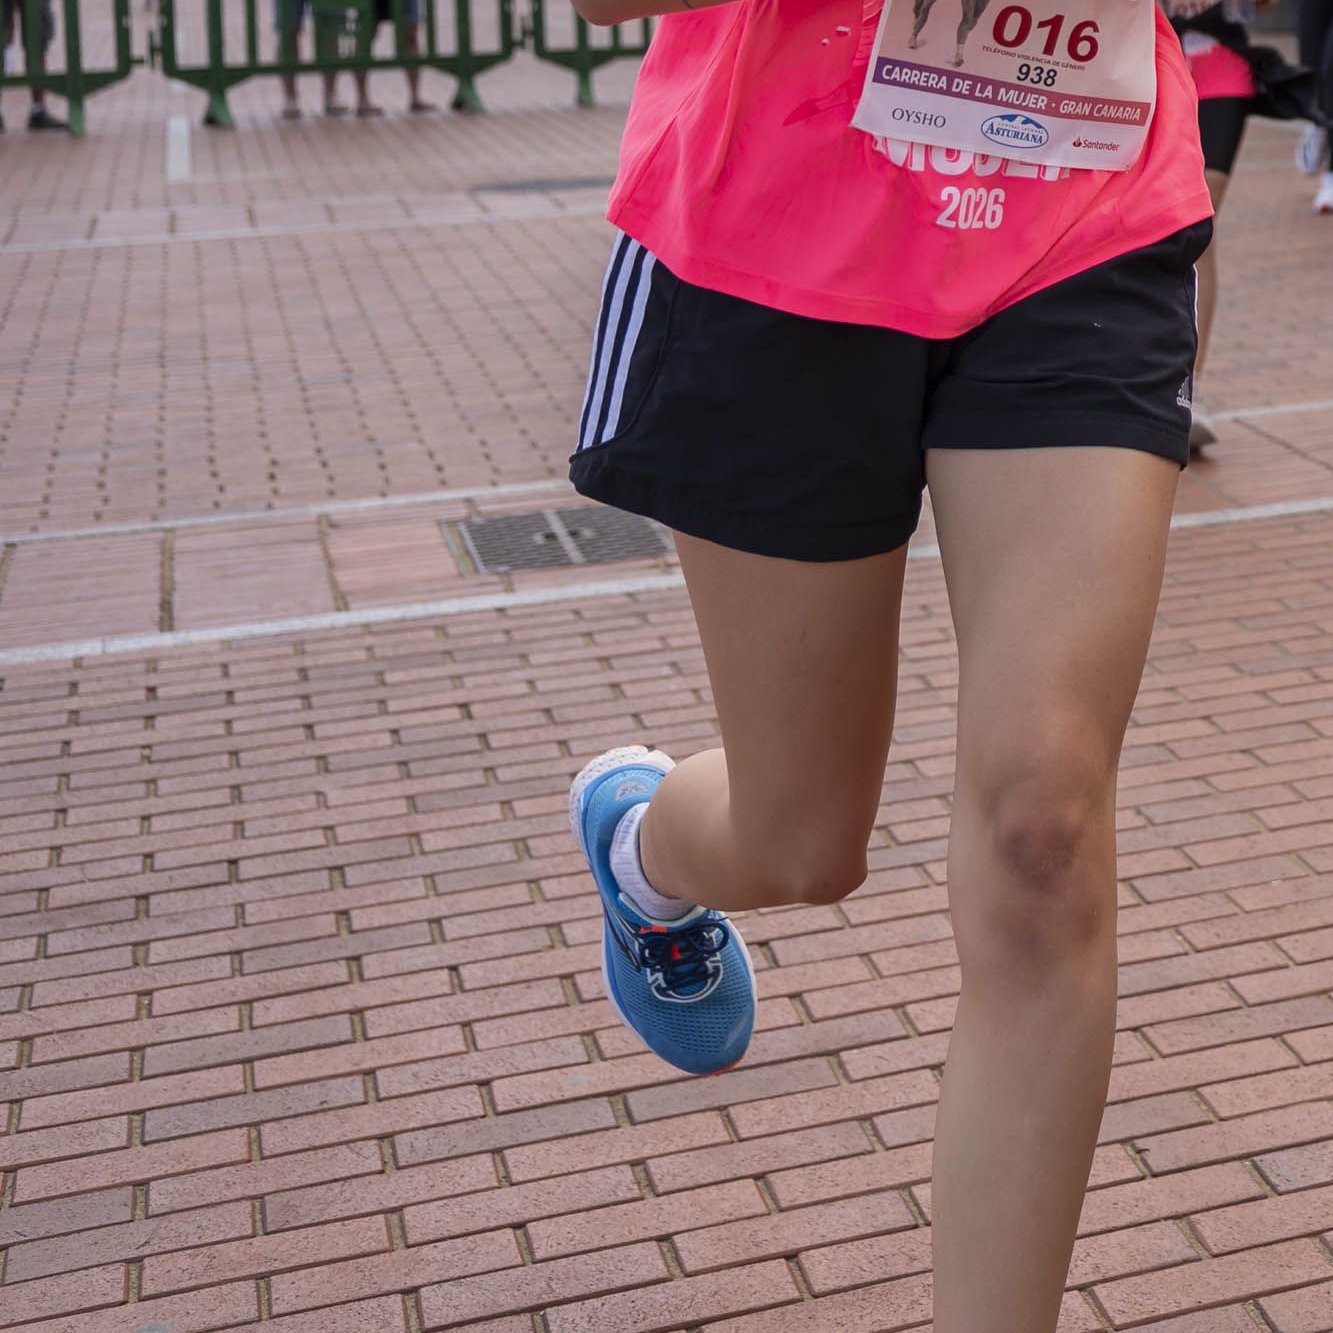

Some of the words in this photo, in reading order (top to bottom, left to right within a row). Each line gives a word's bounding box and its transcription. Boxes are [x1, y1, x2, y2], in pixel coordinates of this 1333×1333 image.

[992, 5, 1099, 63] 016
[1016, 63, 1058, 87] 938
[882, 64, 948, 91] CARRERA
[951, 77, 971, 94] DE
[974, 82, 994, 100] LA
[997, 87, 1048, 111] MUJER
[1058, 99, 1091, 117] GRAN
[1093, 103, 1142, 122] CANARIA
[891, 106, 947, 129] OYSHO
[985, 122, 1044, 145] ASTURIANA
[1082, 139, 1120, 152] Santander
[936, 186, 1006, 230] 2026
